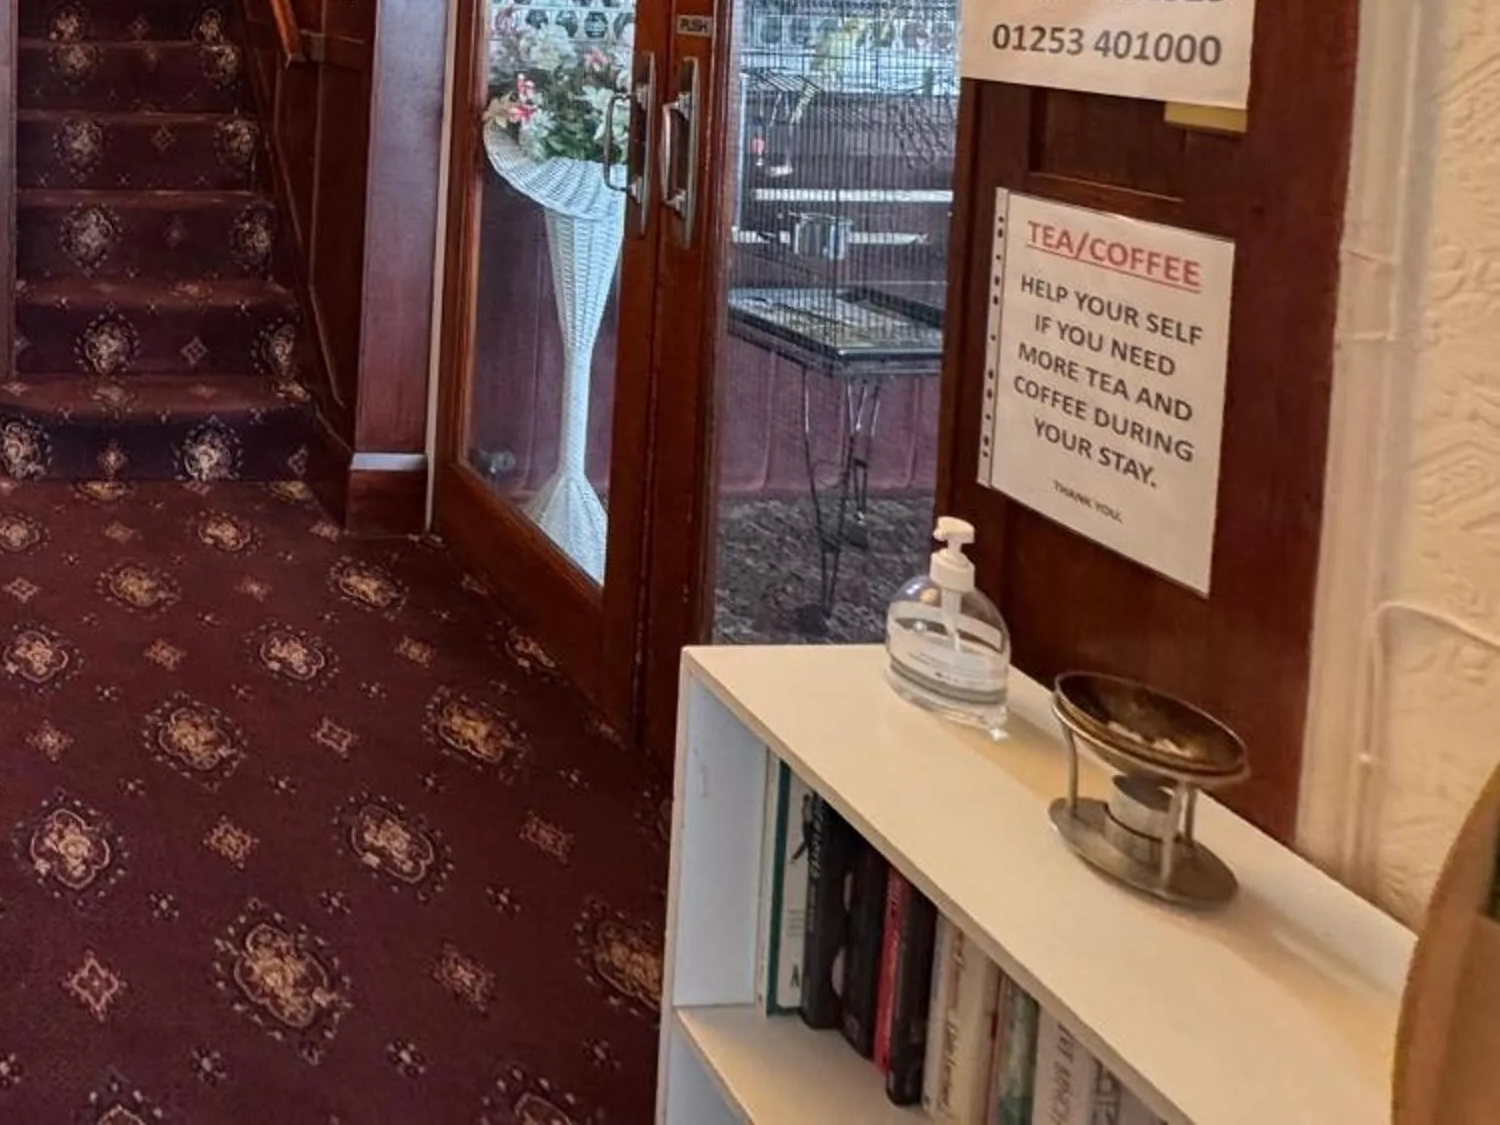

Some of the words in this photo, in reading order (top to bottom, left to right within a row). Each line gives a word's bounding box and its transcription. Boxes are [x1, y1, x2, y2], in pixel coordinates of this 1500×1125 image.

[992, 24, 1085, 55] 01253
[1094, 29, 1222, 67] 401000
[1028, 220, 1201, 286] TEA/COFFEE
[1021, 274, 1068, 304] HELP
[1075, 290, 1139, 328] YOUR
[1146, 313, 1204, 346] SELF
[1035, 314, 1052, 333] IF
[1057, 320, 1103, 352] YOU
[1111, 339, 1176, 377] NEED
[1018, 343, 1079, 382] MORE
[1086, 366, 1130, 401] TEA
[1136, 386, 1194, 422] AND
[1014, 375, 1087, 421] COFFEE
[1095, 407, 1195, 463] DURING
[1034, 417, 1093, 461] YOUR
[1097, 445, 1158, 489] STAY.
[1053, 479, 1091, 508] THANK
